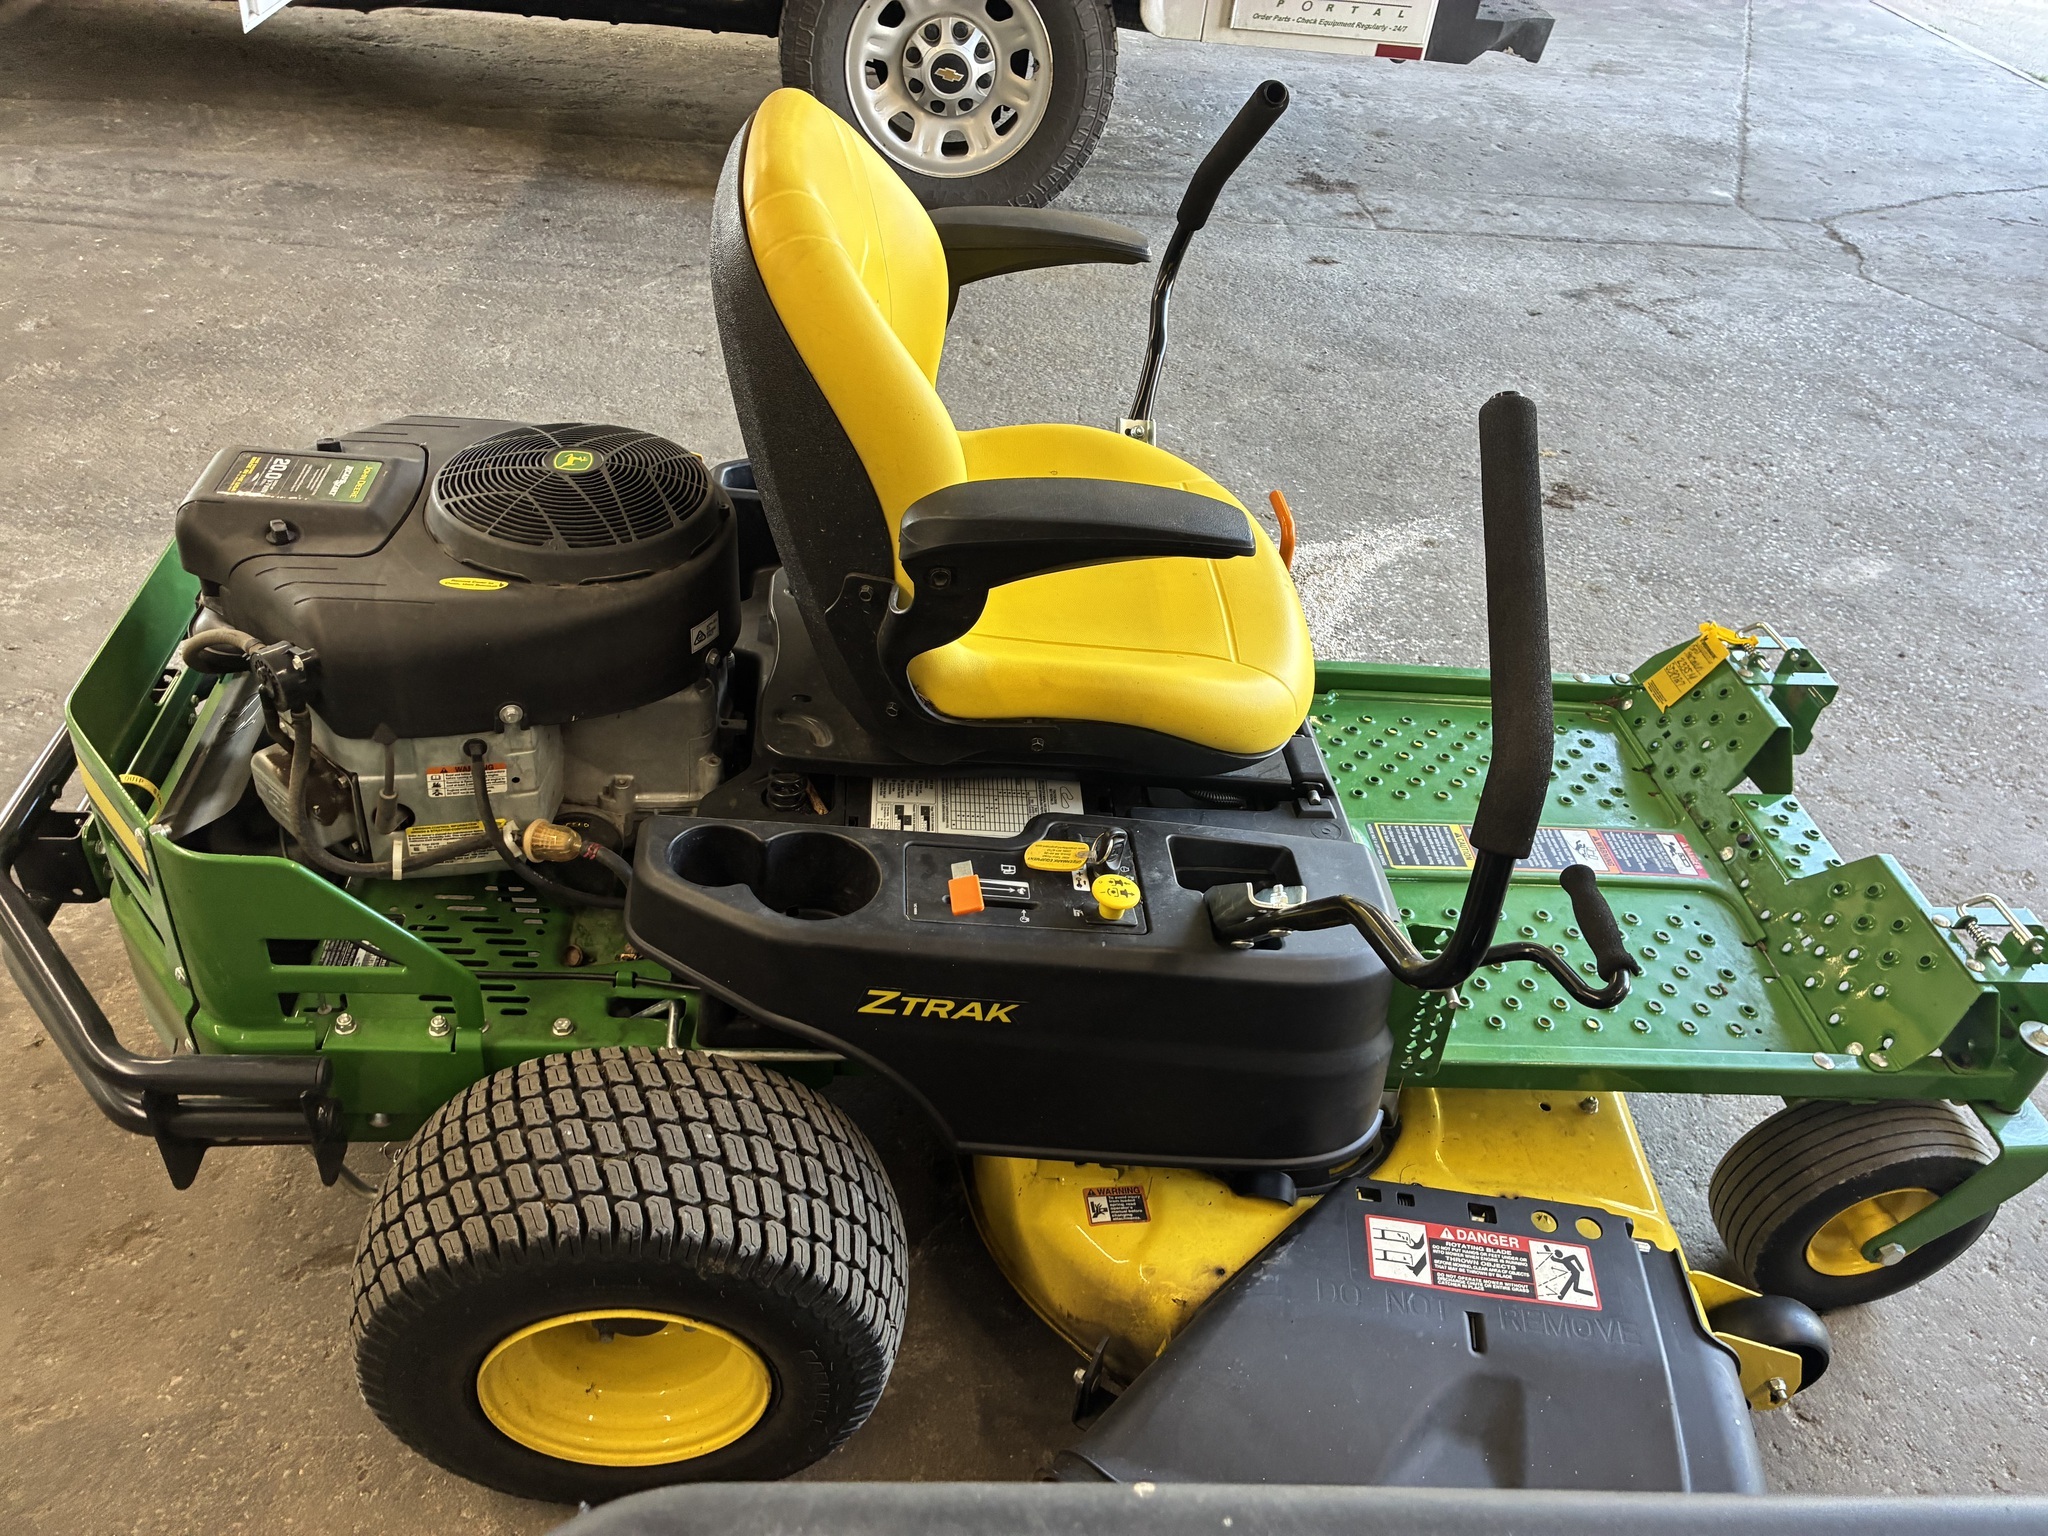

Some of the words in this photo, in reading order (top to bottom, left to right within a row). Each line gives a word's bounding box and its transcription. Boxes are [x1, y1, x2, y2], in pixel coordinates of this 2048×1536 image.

[1319, 19, 1355, 28] Equipment
[1355, 22, 1388, 31] Regularly
[264, 457, 291, 480] 20.0
[350, 480, 366, 499] DEERE
[1459, 838, 1472, 860] CAUTION
[1595, 841, 1615, 867] WARNING
[857, 989, 1020, 1023] ZTRAK
[1097, 1186, 1140, 1195] WARNING
[1445, 1241, 1485, 1251] ROTATING
[1486, 1247, 1512, 1255] BLADE
[1456, 1229, 1519, 1248] DANGER
[1445, 1256, 1479, 1265] THROWN
[1480, 1261, 1516, 1270] OBJECTS
[1315, 1277, 1361, 1306] DO
[1385, 1288, 1447, 1321] NOT
[1498, 1306, 1641, 1345] REMOVE
